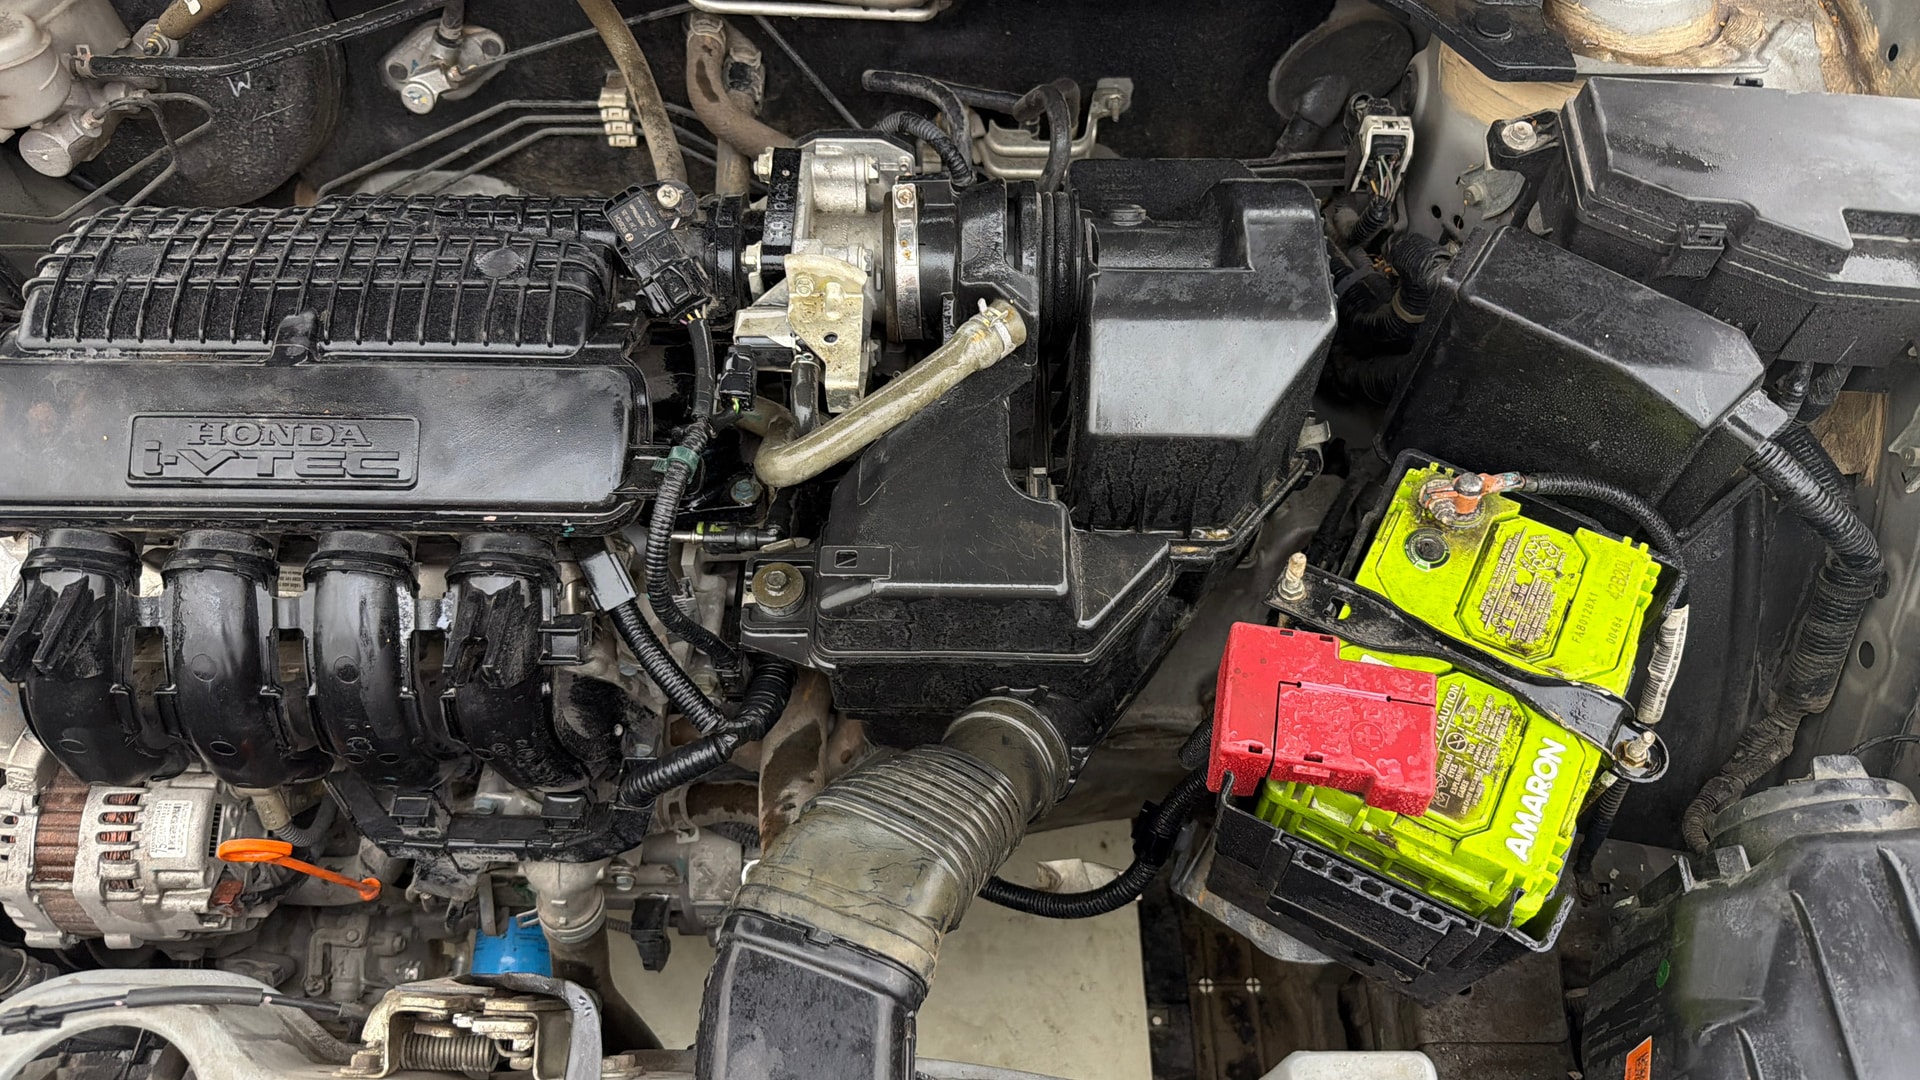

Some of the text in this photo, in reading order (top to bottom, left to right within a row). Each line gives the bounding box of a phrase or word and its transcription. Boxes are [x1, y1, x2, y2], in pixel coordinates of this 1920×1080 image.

[187, 422, 372, 447] HONDA
[143, 440, 400, 477] i-VTEC
[1434, 683, 1459, 731] CAUTION
[1457, 779, 1469, 798] GASES
[1505, 737, 1567, 862] AMARON
